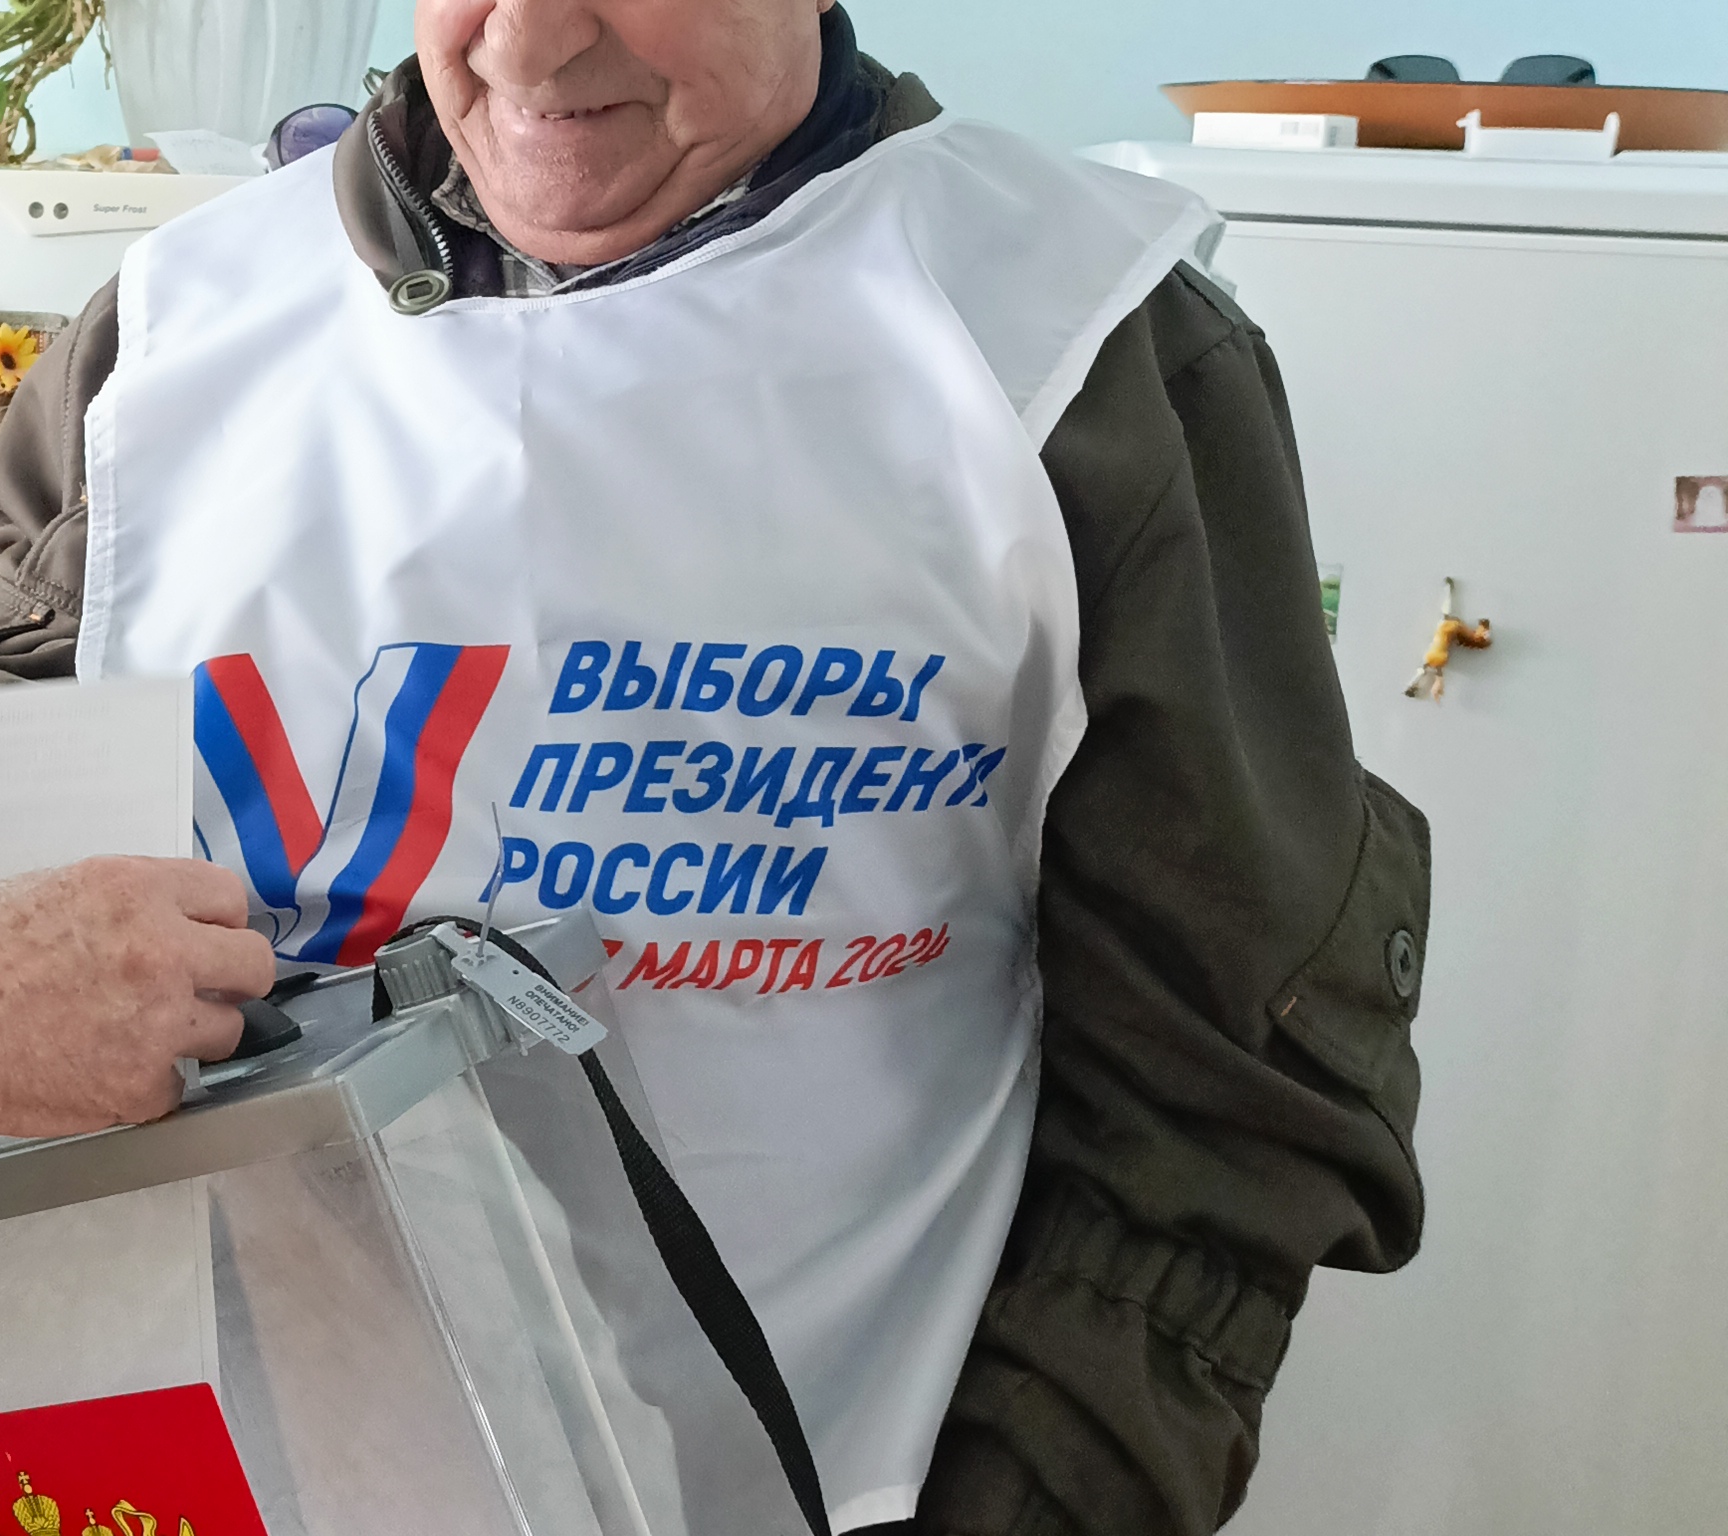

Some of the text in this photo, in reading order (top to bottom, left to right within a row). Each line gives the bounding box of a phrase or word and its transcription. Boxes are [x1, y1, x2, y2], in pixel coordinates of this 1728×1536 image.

[93, 203, 147, 214] Super Frost
[549, 641, 945, 722] ВЫБОРЫ
[480, 837, 828, 916] РОССИИ
[617, 939, 823, 994] МАРТА
[826, 924, 949, 988] 2024
[507, 995, 570, 1044] N8907772
[525, 990, 580, 1033] ОПЕЧАТАНО!
[534, 984, 590, 1027] ВНИМАНИЕ!
